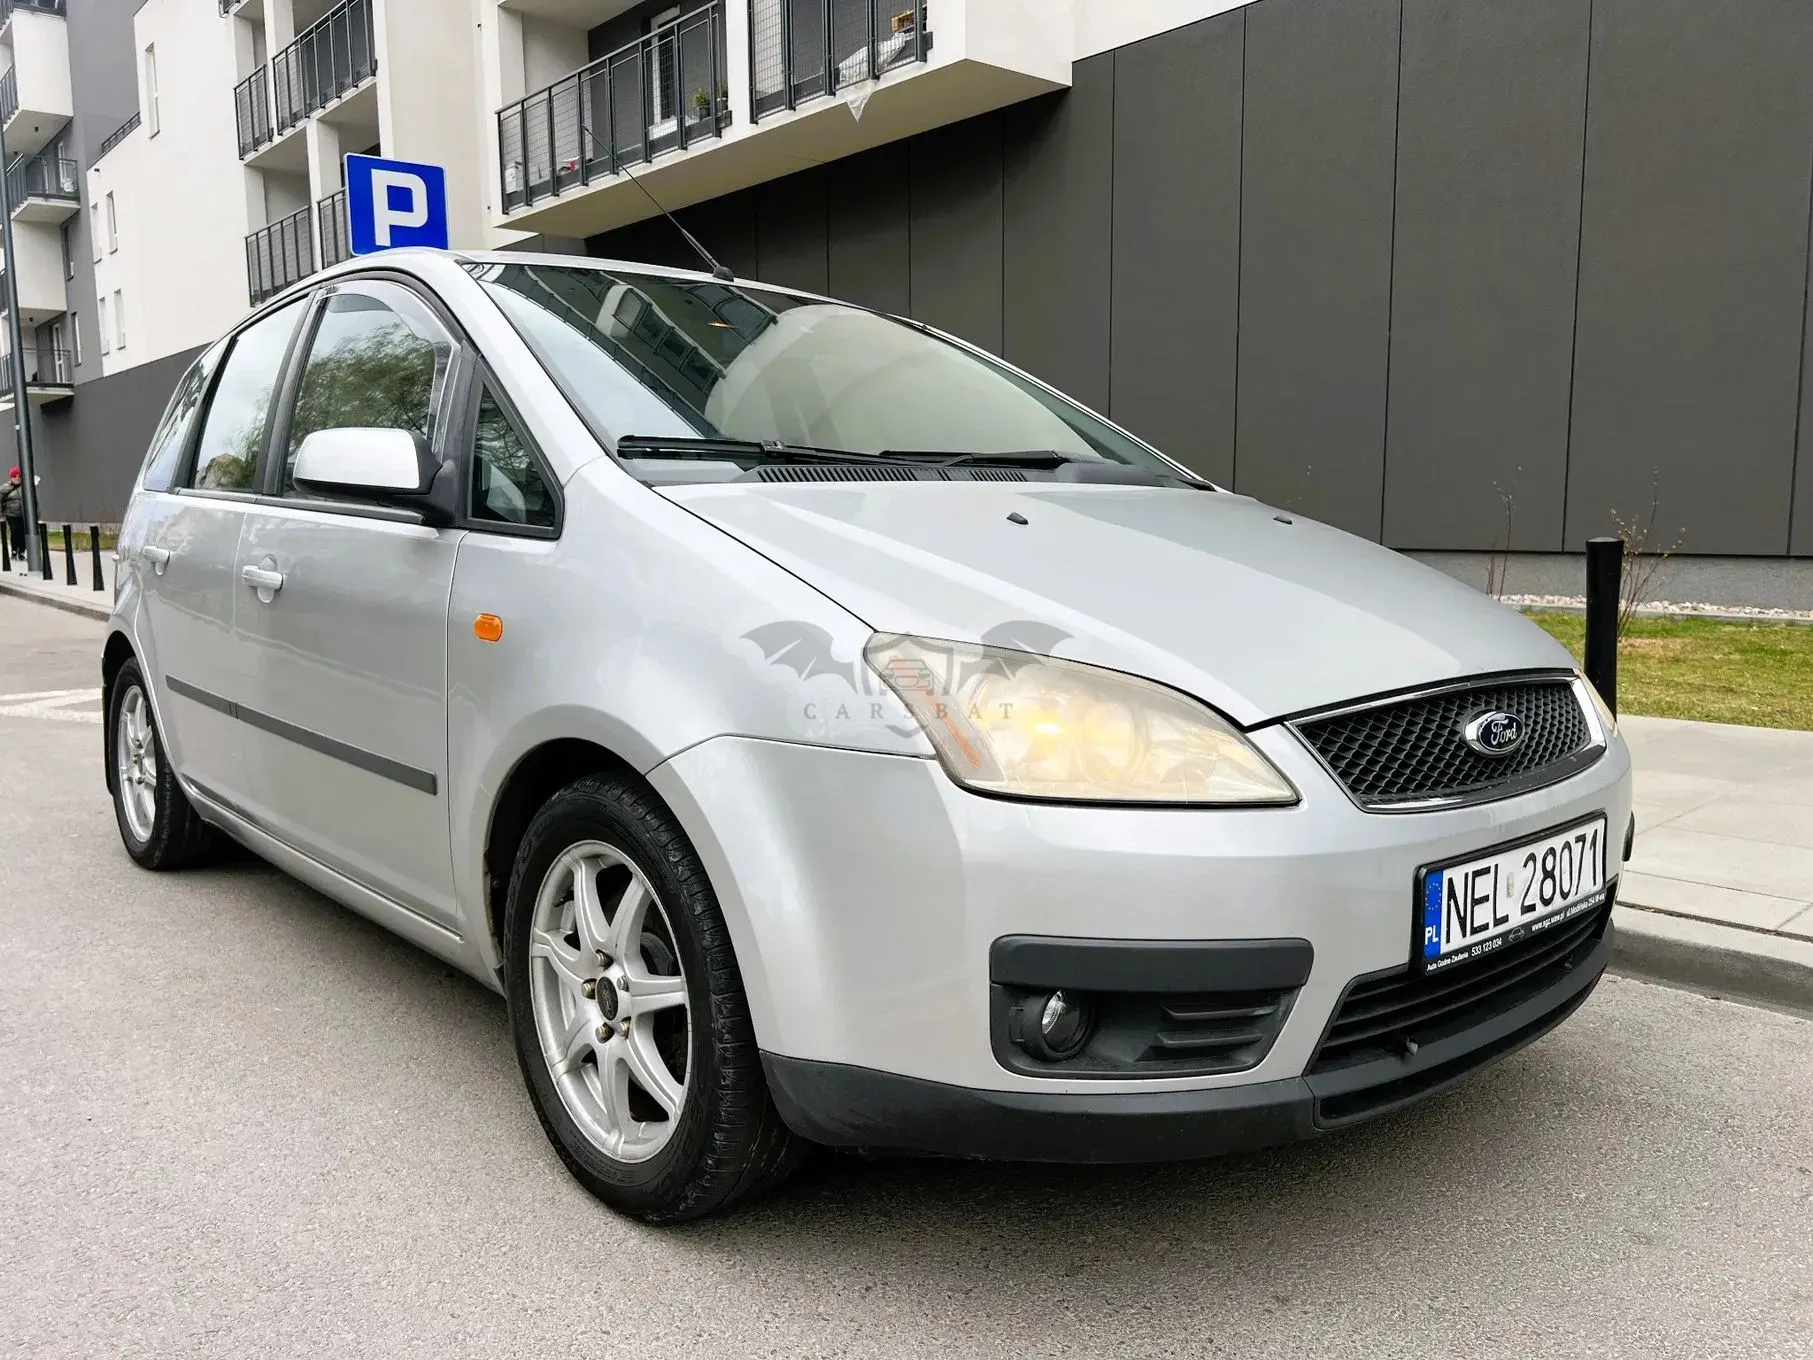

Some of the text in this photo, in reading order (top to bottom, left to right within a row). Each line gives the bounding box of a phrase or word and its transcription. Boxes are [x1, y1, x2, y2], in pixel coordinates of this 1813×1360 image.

[371, 168, 428, 247] P
[1491, 719, 1517, 745] Ford
[1445, 828, 1598, 945] NEL 28071
[1424, 926, 1439, 945] PL
[1471, 945, 1482, 957] 533
[1482, 940, 1492, 952] 123
